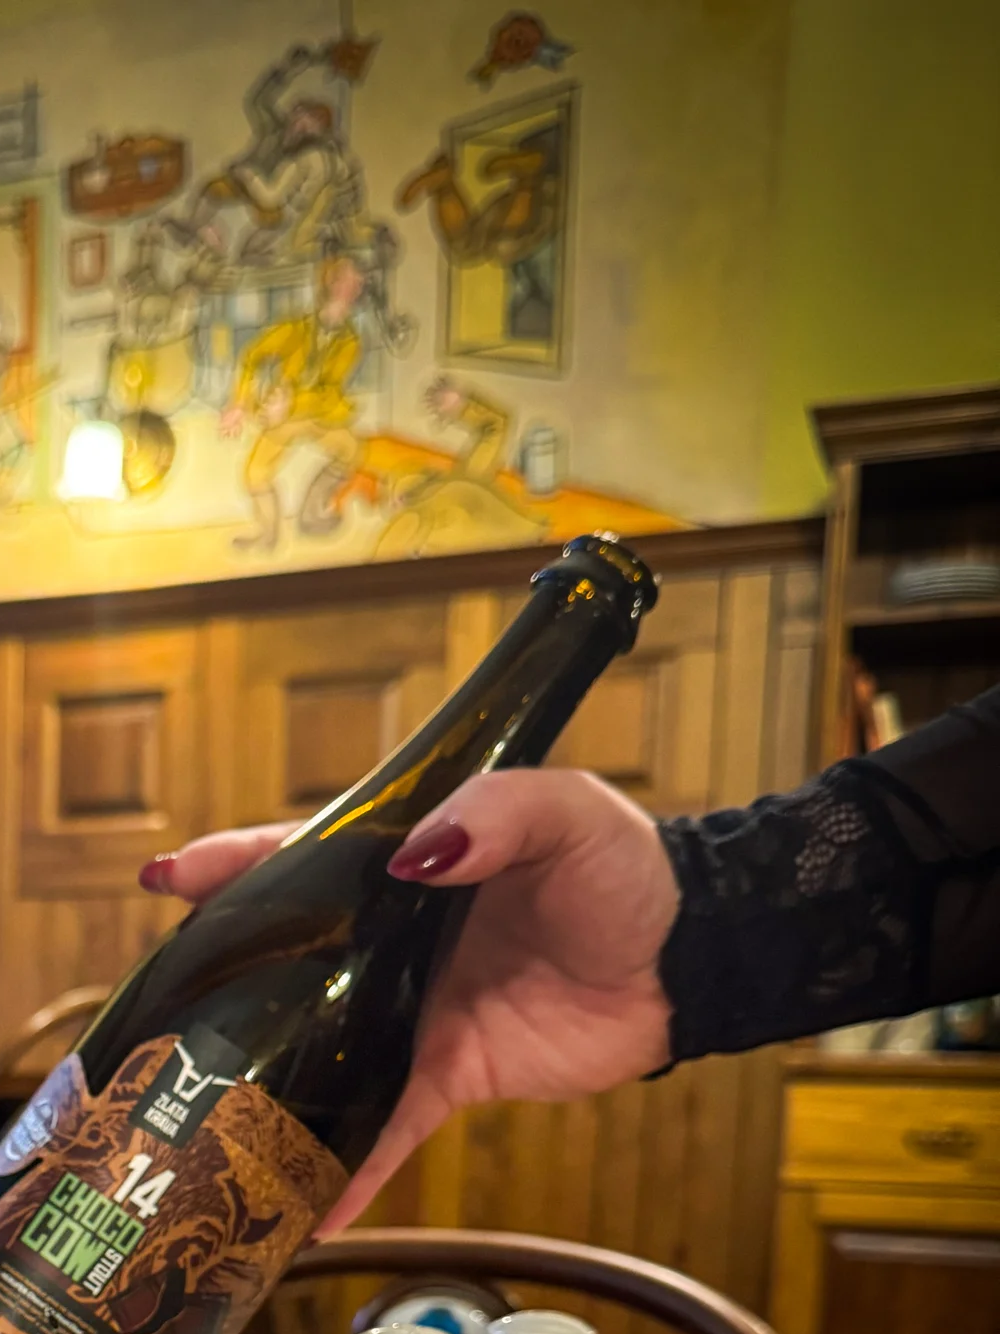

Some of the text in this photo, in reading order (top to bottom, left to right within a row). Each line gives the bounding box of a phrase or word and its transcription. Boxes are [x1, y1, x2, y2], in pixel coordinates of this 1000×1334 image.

[49, 1171, 146, 1256] CHOCO
[113, 1153, 176, 1219] 14
[20, 1203, 107, 1283] COW
[83, 1248, 124, 1296] STOUT
